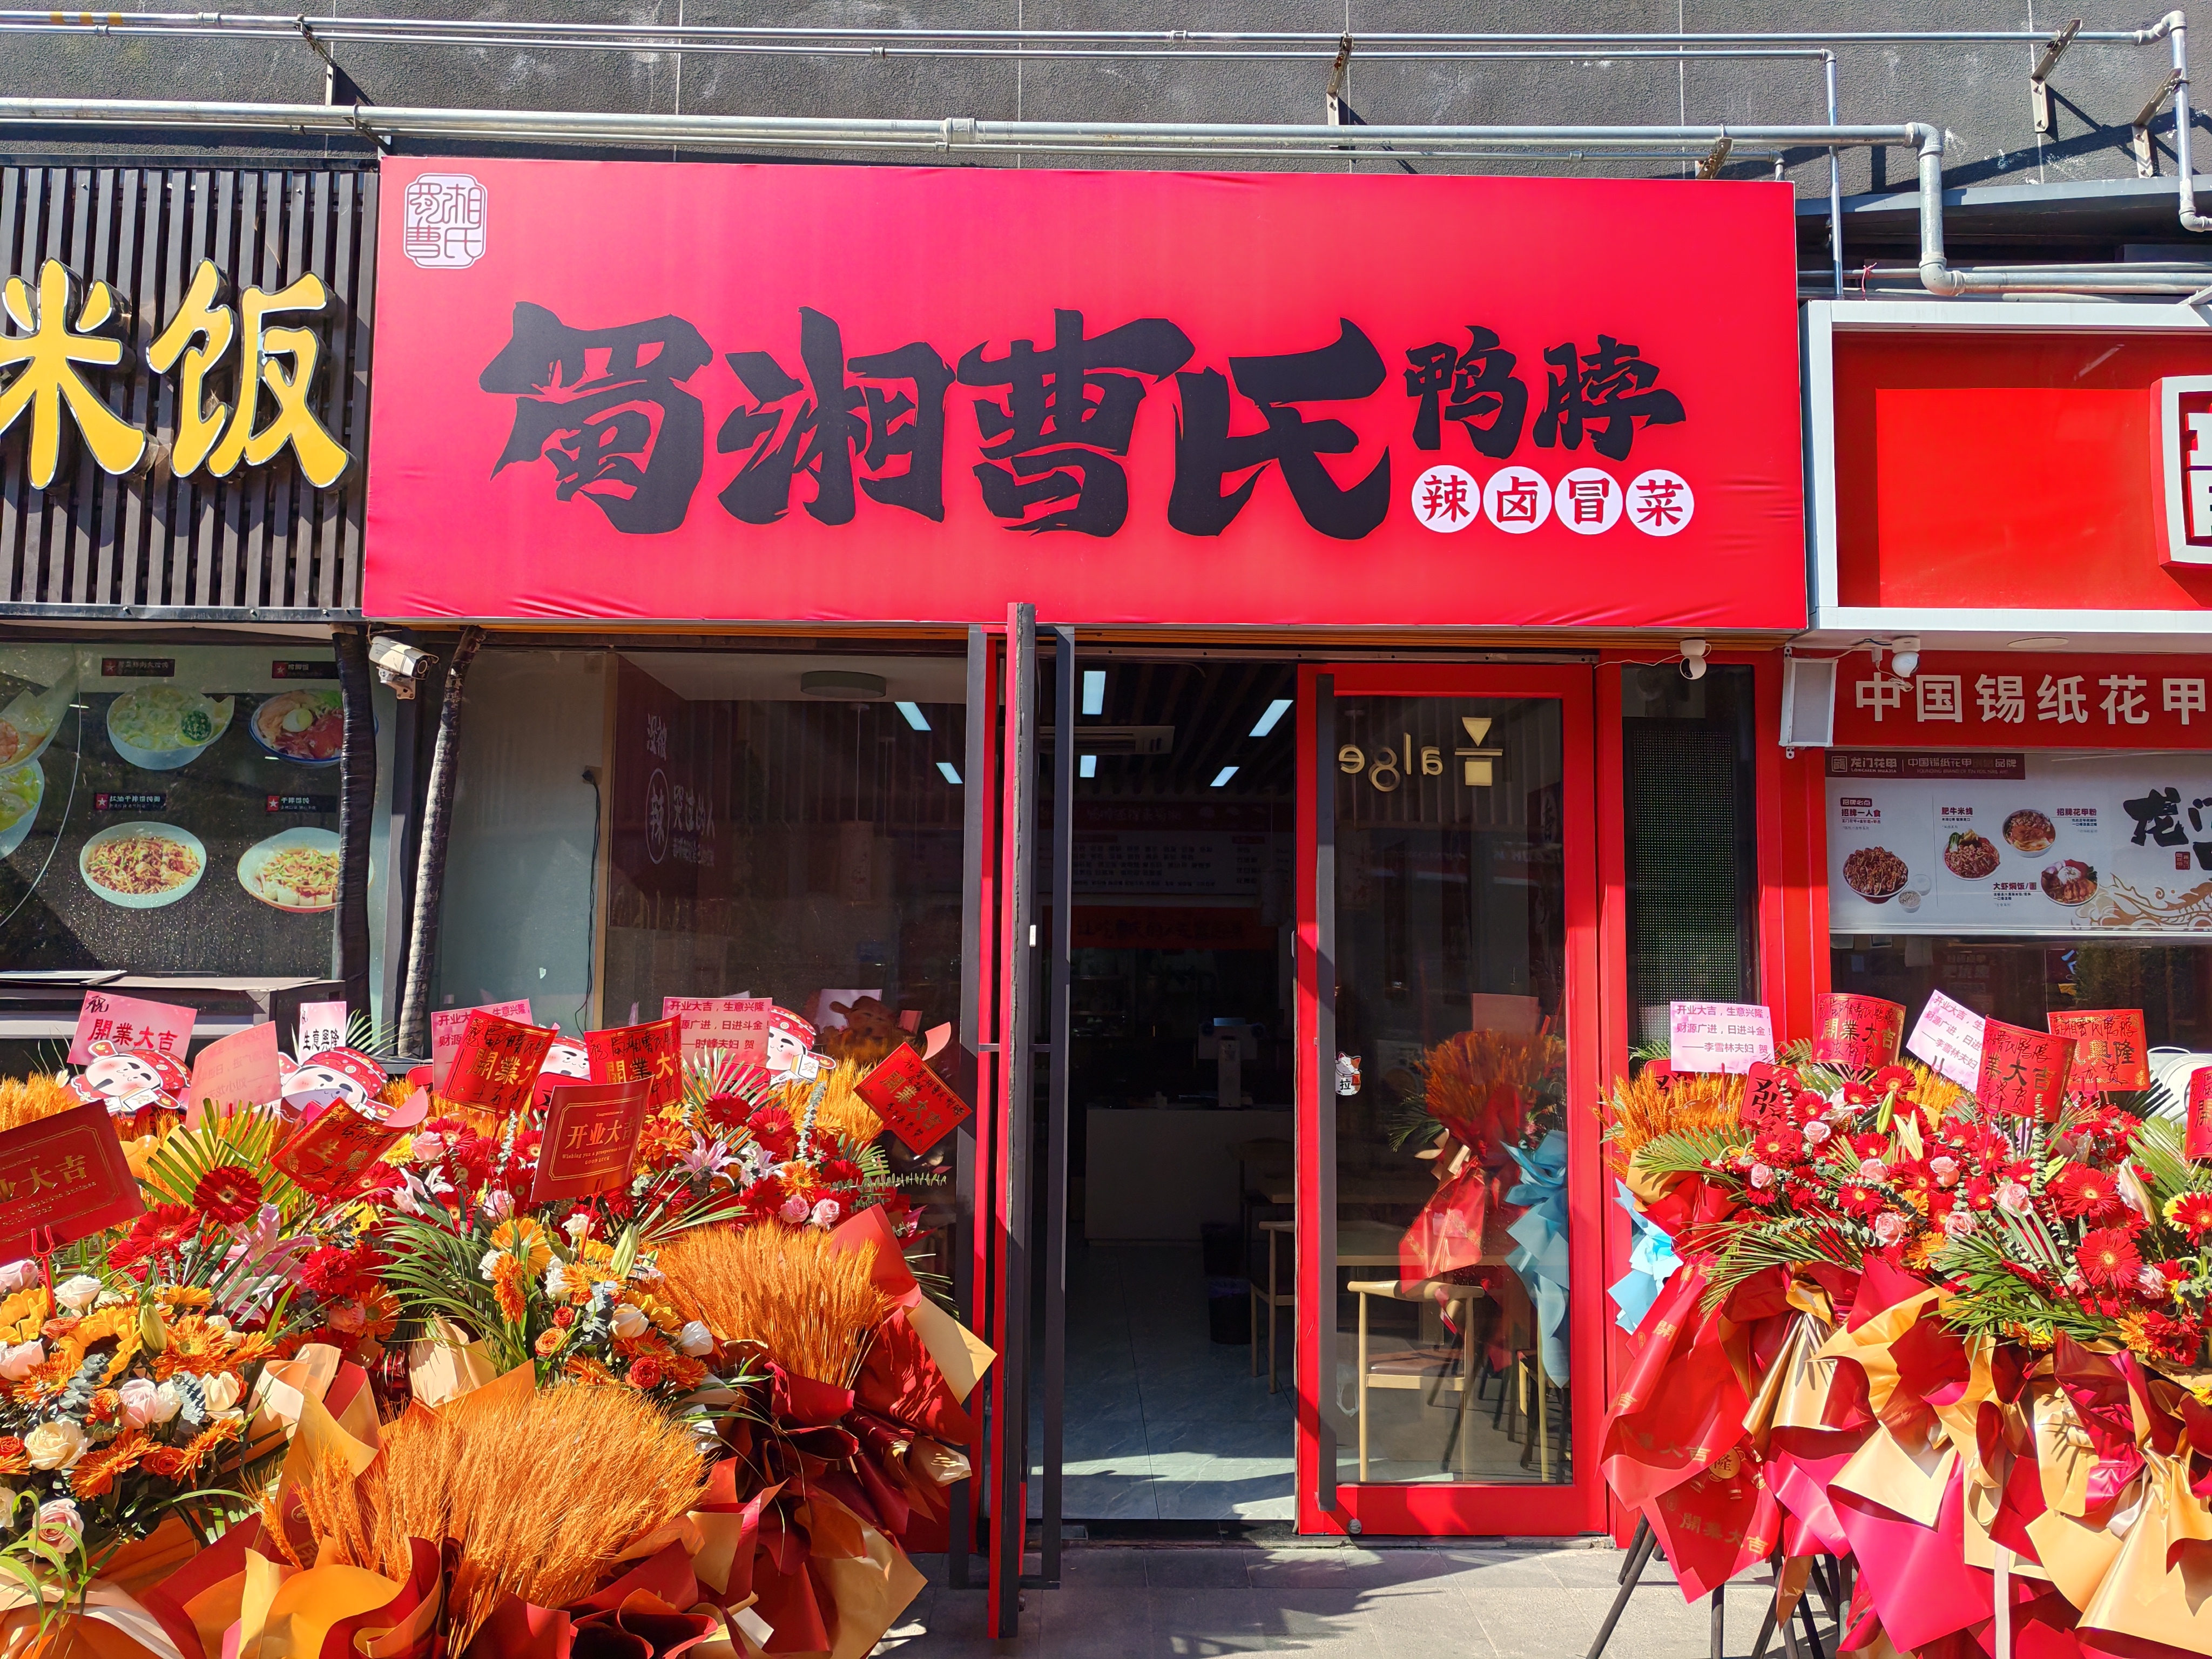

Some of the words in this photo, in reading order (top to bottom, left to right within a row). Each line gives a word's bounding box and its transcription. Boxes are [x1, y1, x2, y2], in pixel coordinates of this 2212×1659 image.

[0, 257, 351, 490] 米饭
[479, 301, 1391, 540] 蜀湘曹氏
[1403, 325, 1687, 461] 鸭脖
[1420, 474, 1685, 527] 辣卤冒菜
[1856, 672, 2207, 725] 中国锡纸花甲
[1677, 1005, 1769, 1019] 开业大吉，生意兴隆，
[88, 1019, 178, 1052] 開業大吉
[745, 1040, 754, 1050] 贺
[1677, 1023, 1771, 1036] 财源广进，日进斗金！
[1820, 1017, 1896, 1050] 開業大吉
[1339, 1078, 1351, 1090] 拉
[1985, 1054, 2055, 1091] 業大吉
[565, 1117, 637, 1149] 开业大吉
